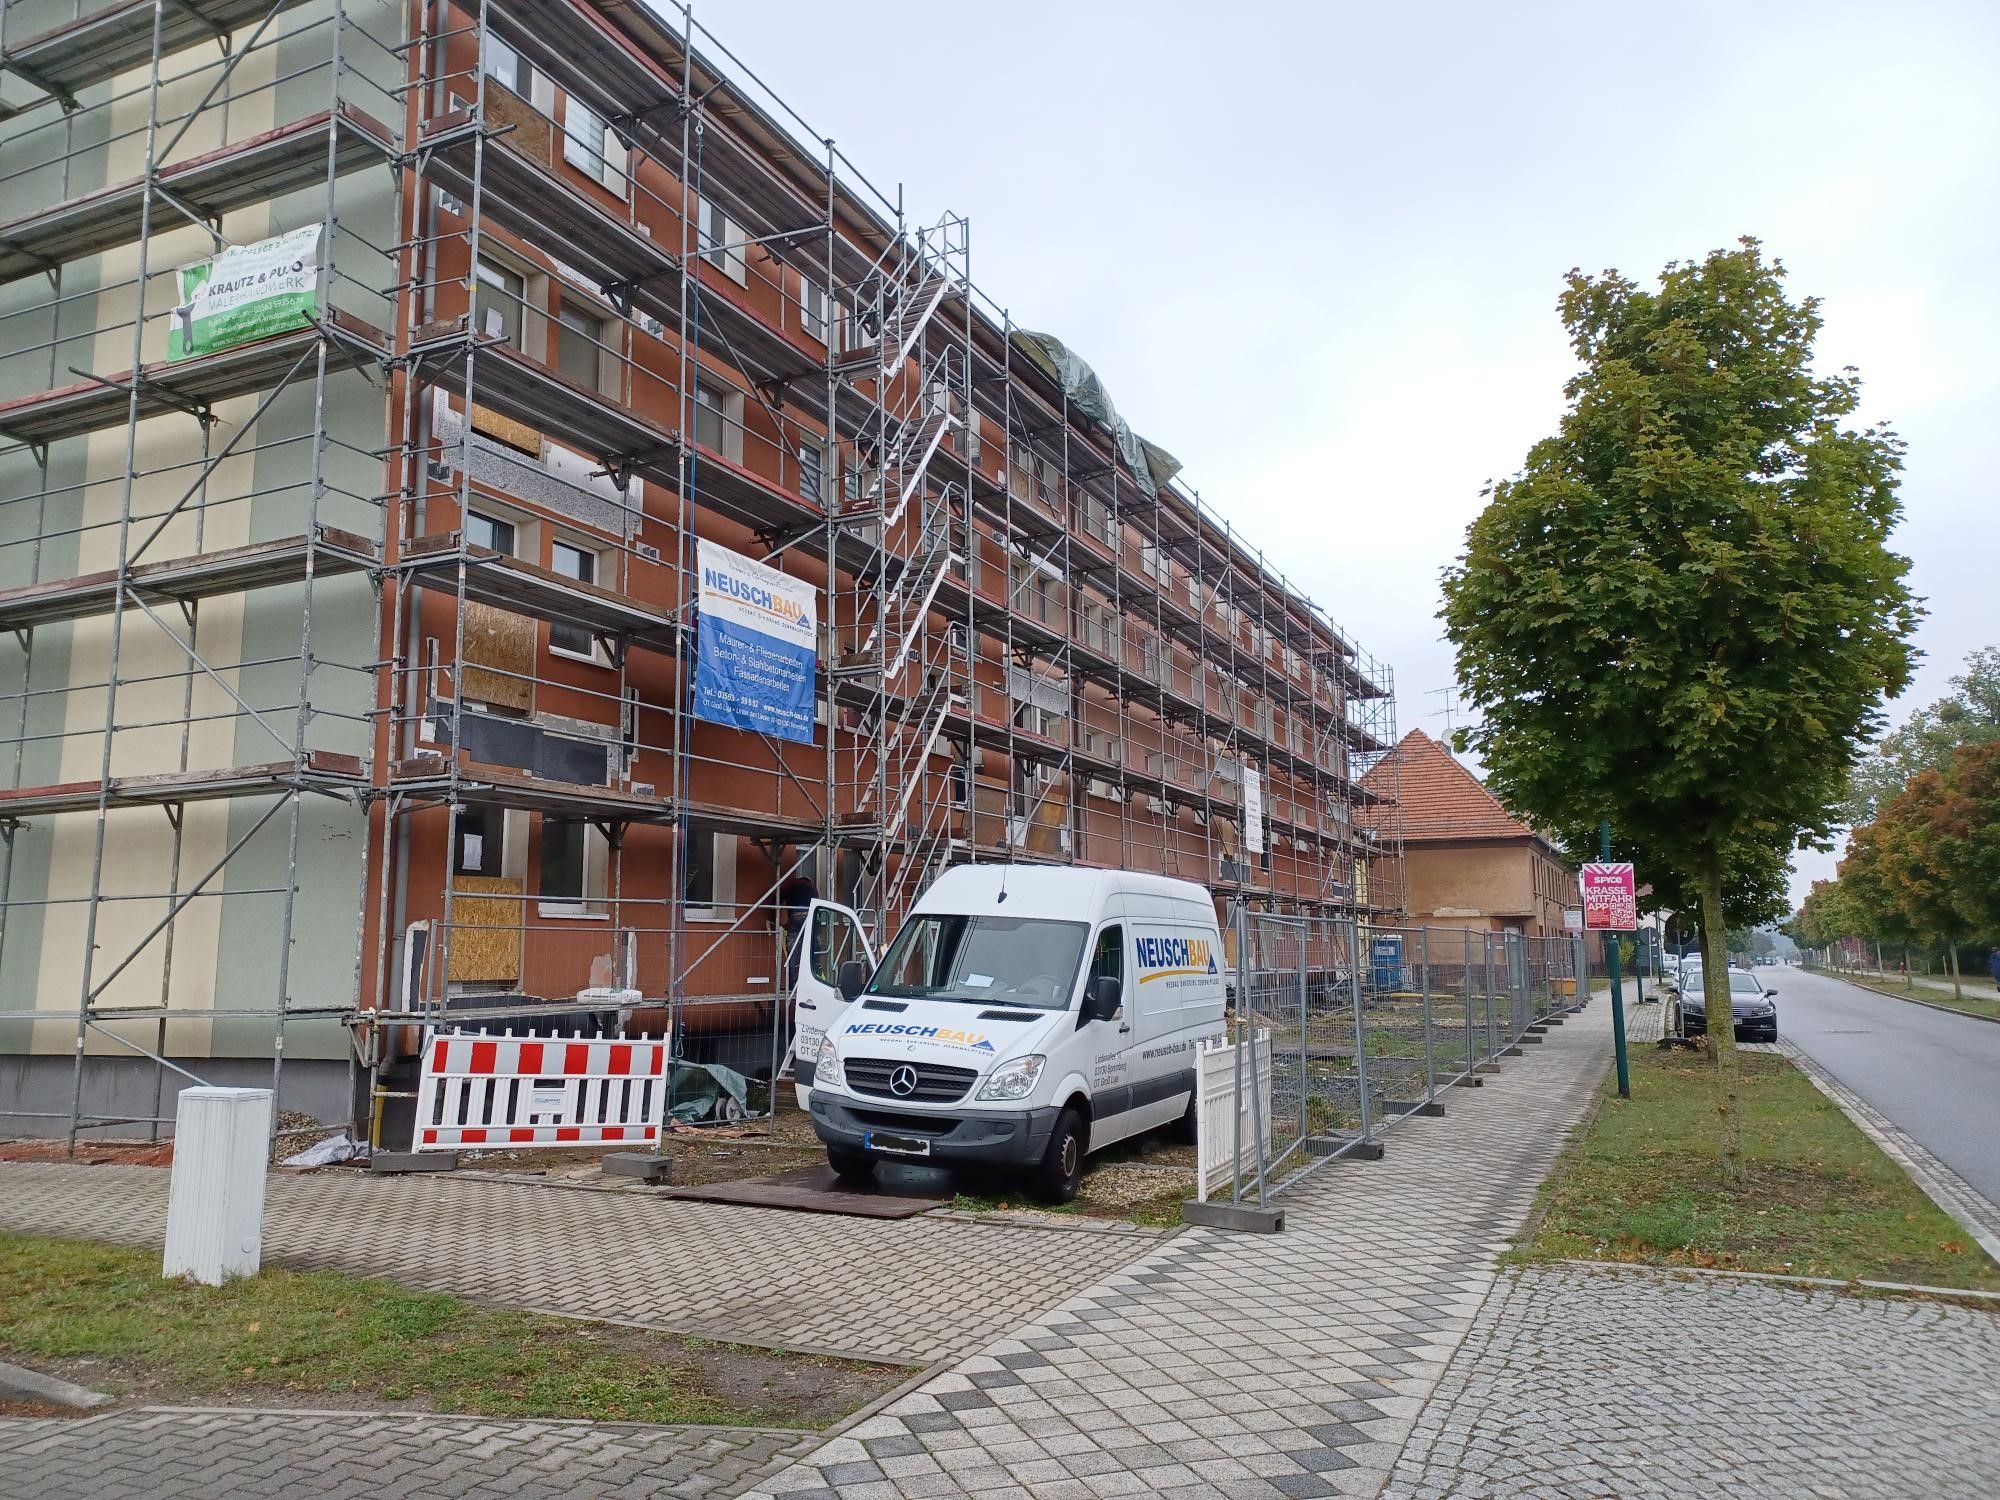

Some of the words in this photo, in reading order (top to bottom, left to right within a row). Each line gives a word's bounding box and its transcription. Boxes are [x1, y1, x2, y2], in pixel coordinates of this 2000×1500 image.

[209, 275, 254, 297] KRAUTZ
[257, 272, 266, 284] &
[705, 567, 804, 619] NEUSCHBAU
[713, 646, 739, 660] Beton-
[742, 655, 747, 665] &
[720, 632, 748, 649] Maurer-
[749, 643, 754, 653] &
[756, 645, 803, 669] Fliesenarbeiten
[734, 666, 790, 692] Fassadenarbeiten
[763, 704, 809, 721] www.neusch-bau.de
[1586, 887, 1627, 895] KRASSE
[1587, 895, 1632, 903] MITFAHR
[1587, 903, 1609, 911] APP
[1136, 938, 1209, 968] NEUSCHBAU
[801, 1035, 820, 1047] 03130
[846, 1024, 985, 1043] NEUSCHBAU
[800, 1046, 809, 1055] OT
[1143, 1041, 1187, 1060] www.neusch-bau.de
